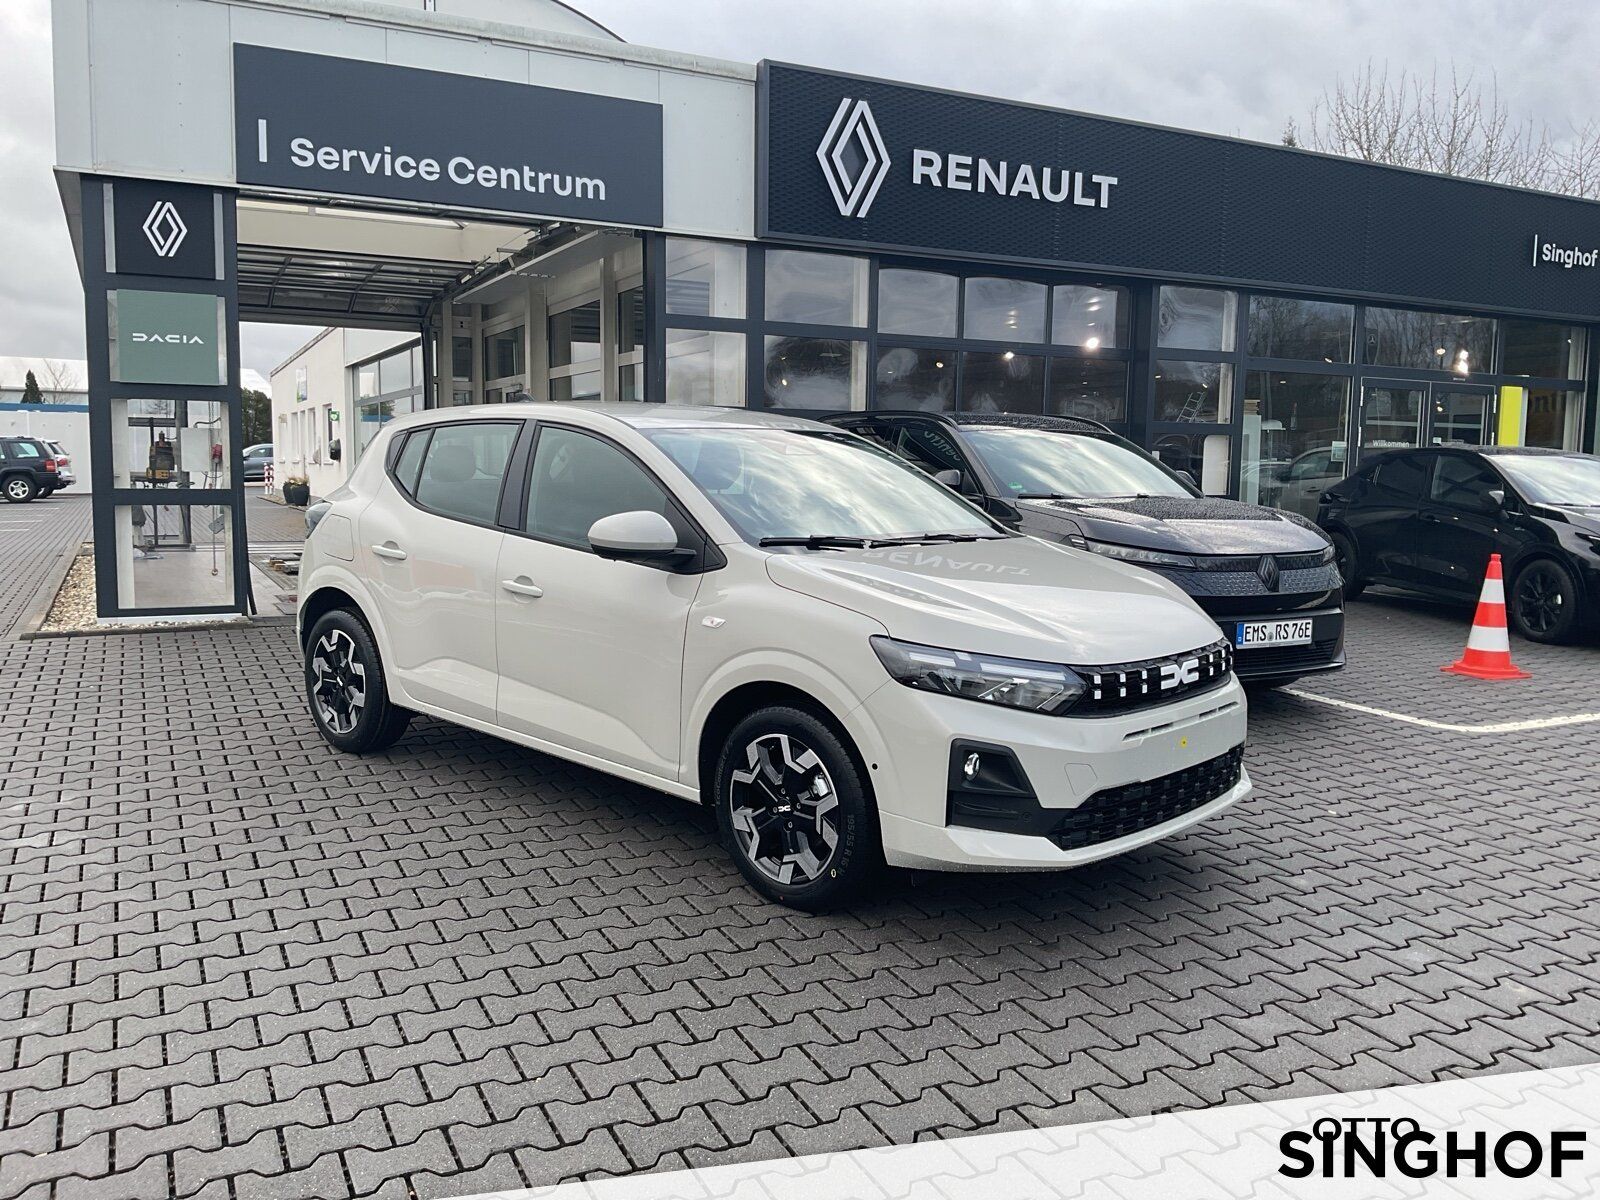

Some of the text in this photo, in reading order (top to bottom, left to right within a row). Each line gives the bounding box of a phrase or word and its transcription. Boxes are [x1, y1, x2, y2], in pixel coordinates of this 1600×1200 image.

[290, 137, 606, 201] Service Centrum
[912, 148, 1118, 209] RENAULT
[1541, 242, 1599, 269] Singhof
[132, 332, 204, 344] DACIA
[1244, 624, 1267, 643] EMS
[1275, 623, 1290, 641] RS
[1291, 621, 1311, 639] 76E
